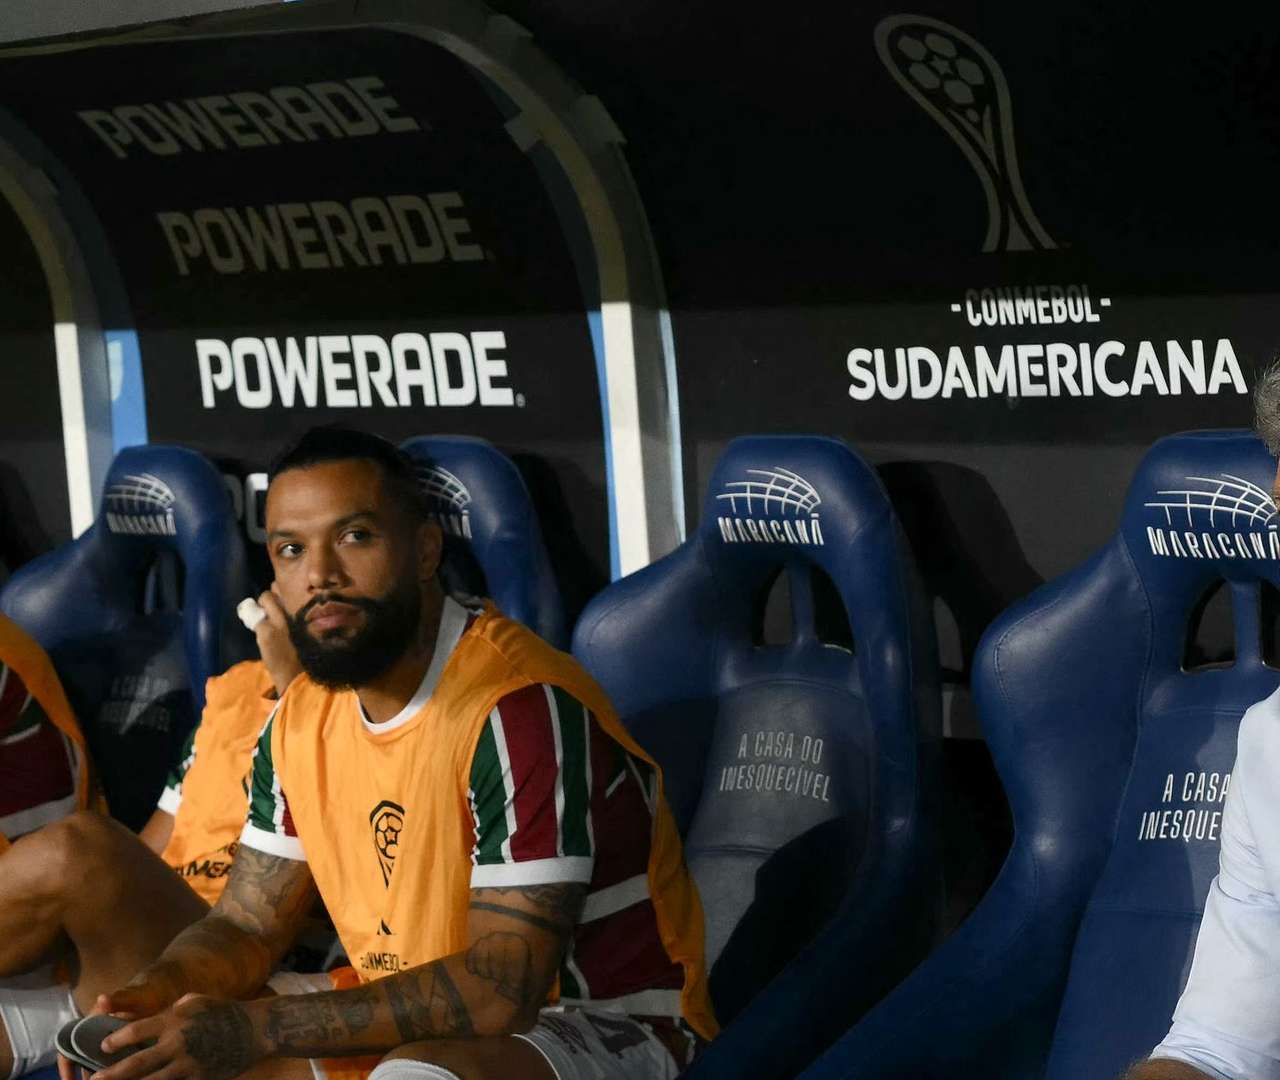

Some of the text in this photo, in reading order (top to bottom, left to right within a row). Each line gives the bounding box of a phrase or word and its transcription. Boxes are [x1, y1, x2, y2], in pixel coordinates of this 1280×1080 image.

[77, 77, 419, 158] POWERADE
[157, 192, 483, 275] POWERADE
[195, 330, 514, 409] POWERADE
[846, 338, 1249, 401] SUDAMERICANA
[754, 731, 794, 759] CASA
[1162, 773, 1174, 802] A
